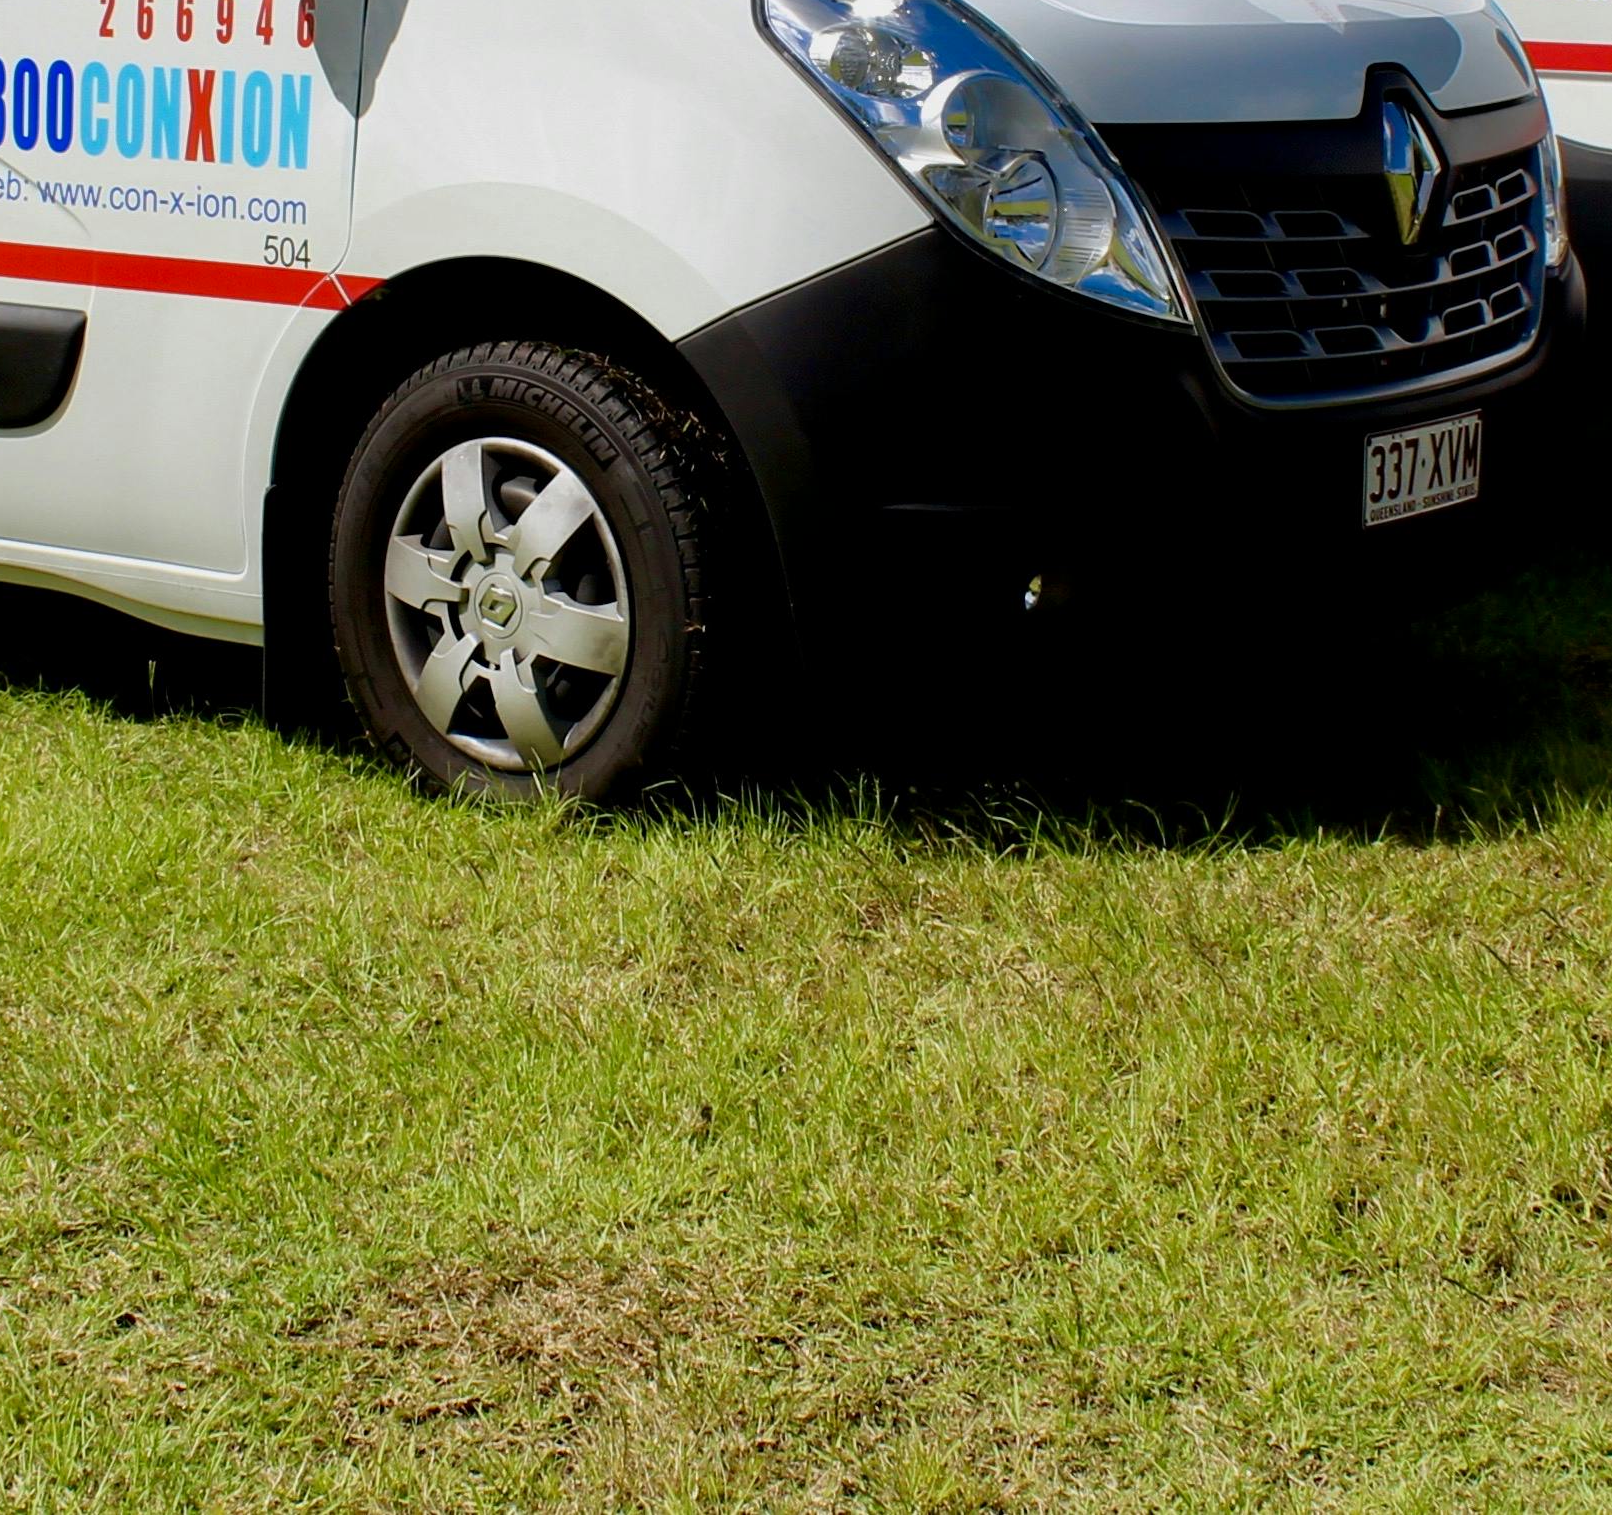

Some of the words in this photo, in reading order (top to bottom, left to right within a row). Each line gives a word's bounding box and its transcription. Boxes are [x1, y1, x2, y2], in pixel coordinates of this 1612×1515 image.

[37, 179, 307, 226] www.con-x-ion.com
[262, 234, 312, 270] 504
[488, 378, 618, 464] MICHELIN
[1369, 499, 1417, 522] QUEENSLAND
[1423, 489, 1455, 510] SUNSHINE
